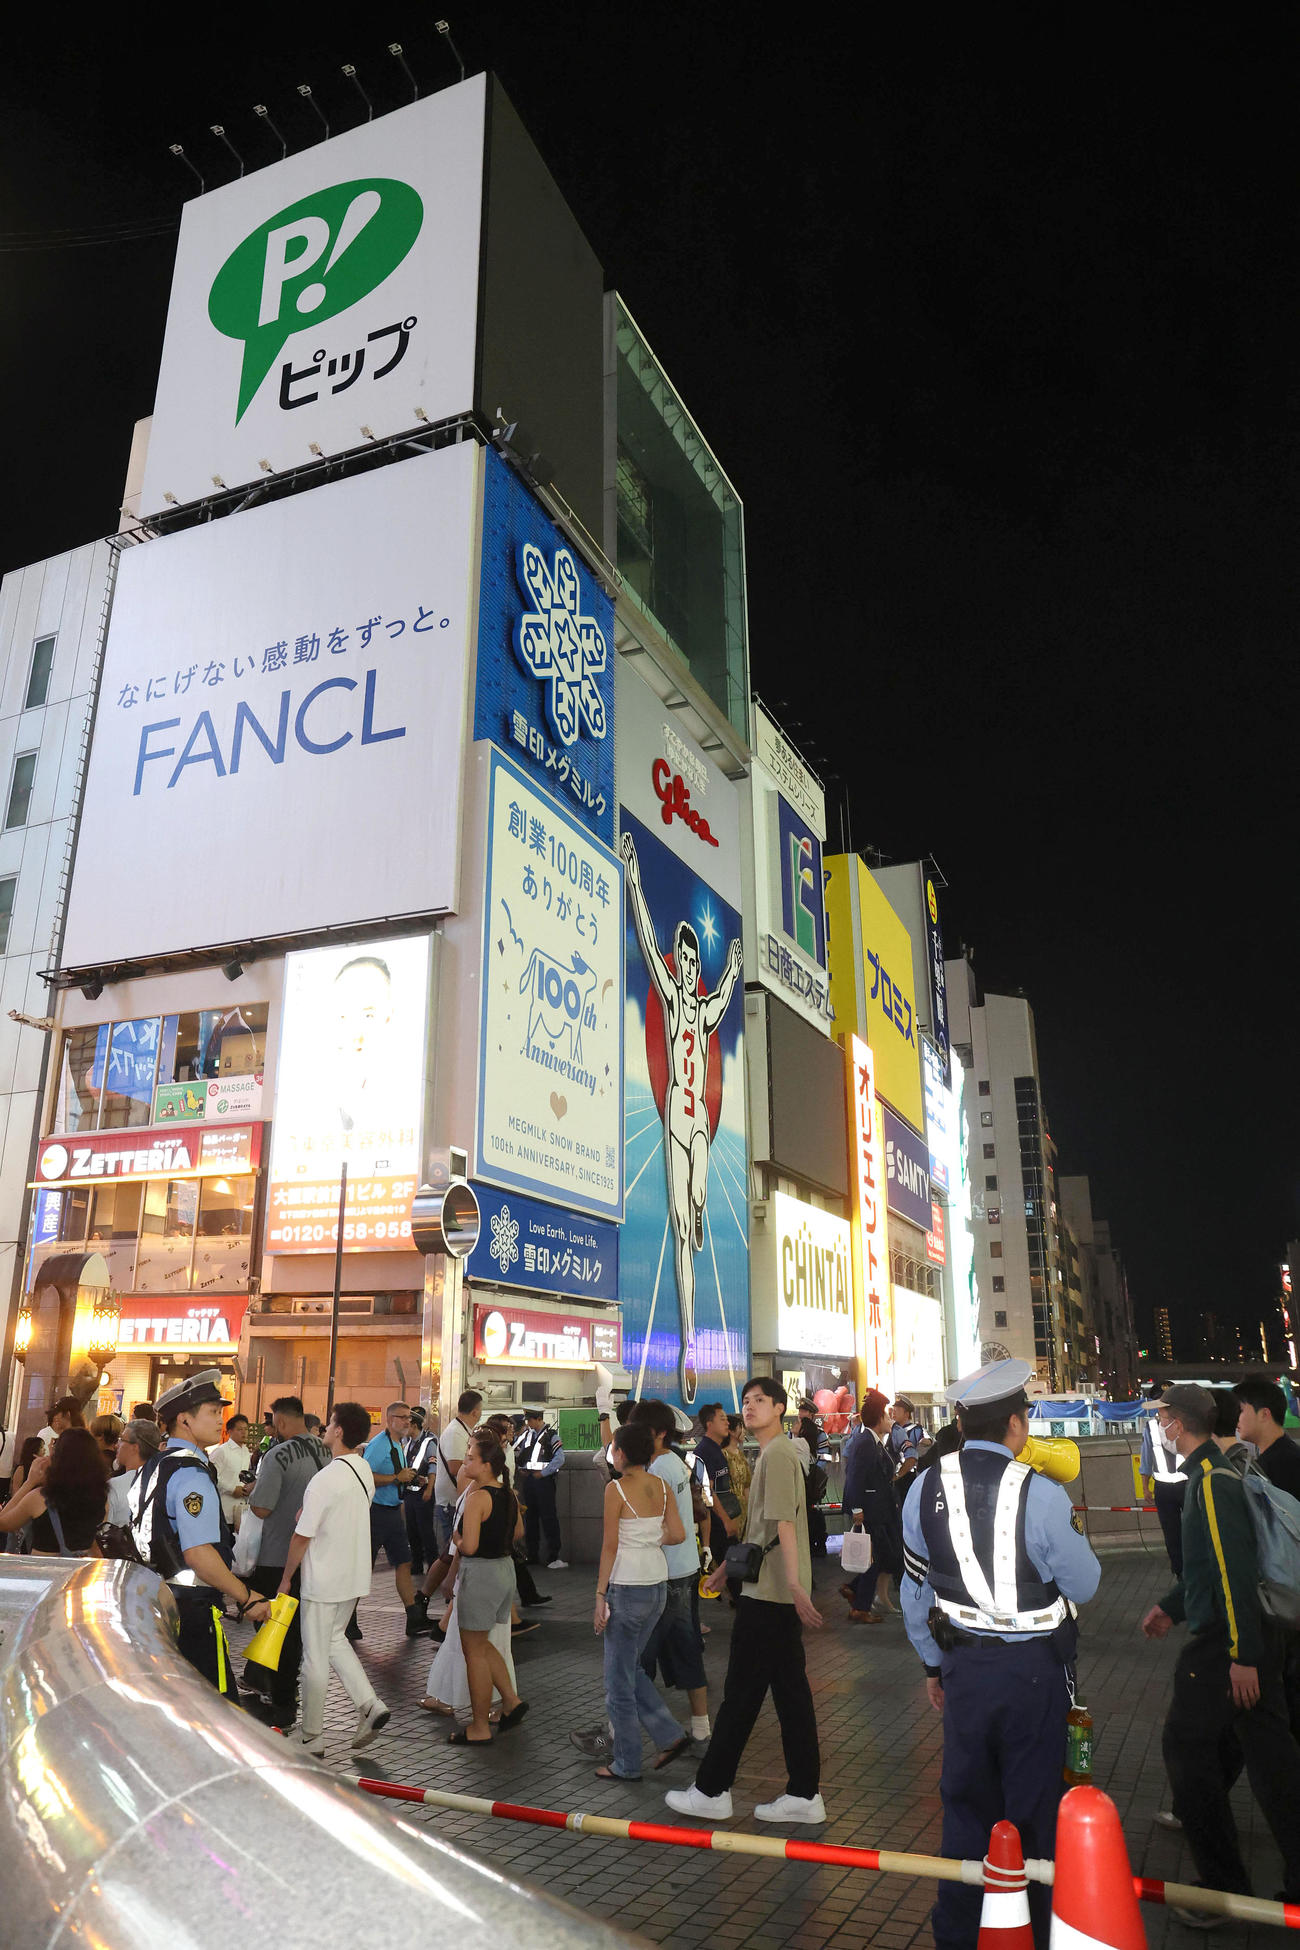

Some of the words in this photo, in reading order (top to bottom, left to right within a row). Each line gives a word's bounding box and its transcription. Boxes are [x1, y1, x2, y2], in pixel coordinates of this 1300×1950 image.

[279, 315, 417, 410] ピップ
[116, 605, 450, 709] なにげない感動をずっと。
[132, 669, 406, 796] FANCL
[513, 708, 606, 816] 雪印メグミルク
[652, 758, 719, 847] Glico
[508, 801, 611, 908] 創業100周年
[522, 864, 599, 945] ありがとう
[767, 933, 836, 1022] 日商エステム
[866, 947, 915, 1049] プロミス
[220, 1082, 255, 1094] MASSAGE
[520, 1041, 598, 1097] Anniversary
[681, 1027, 696, 1118] グリコ
[70, 1147, 192, 1176] ZETTERIA
[490, 1135, 514, 1155] 100th
[508, 1115, 548, 1142] MEGMILK
[549, 1132, 574, 1151] SNOW
[575, 1143, 601, 1163] BRAND
[896, 1147, 931, 1204] SAMTY
[391, 1181, 415, 1199] 2F
[859, 1063, 881, 1393] オリエントホー
[523, 1243, 603, 1284] 雪印メグミルク
[529, 1219, 546, 1236] Love
[547, 1224, 567, 1241] Earth.
[569, 1230, 584, 1246] Love
[585, 1234, 598, 1249] Life.
[782, 1221, 849, 1315] CHINTAI
[119, 1317, 230, 1342] ETTERIA
